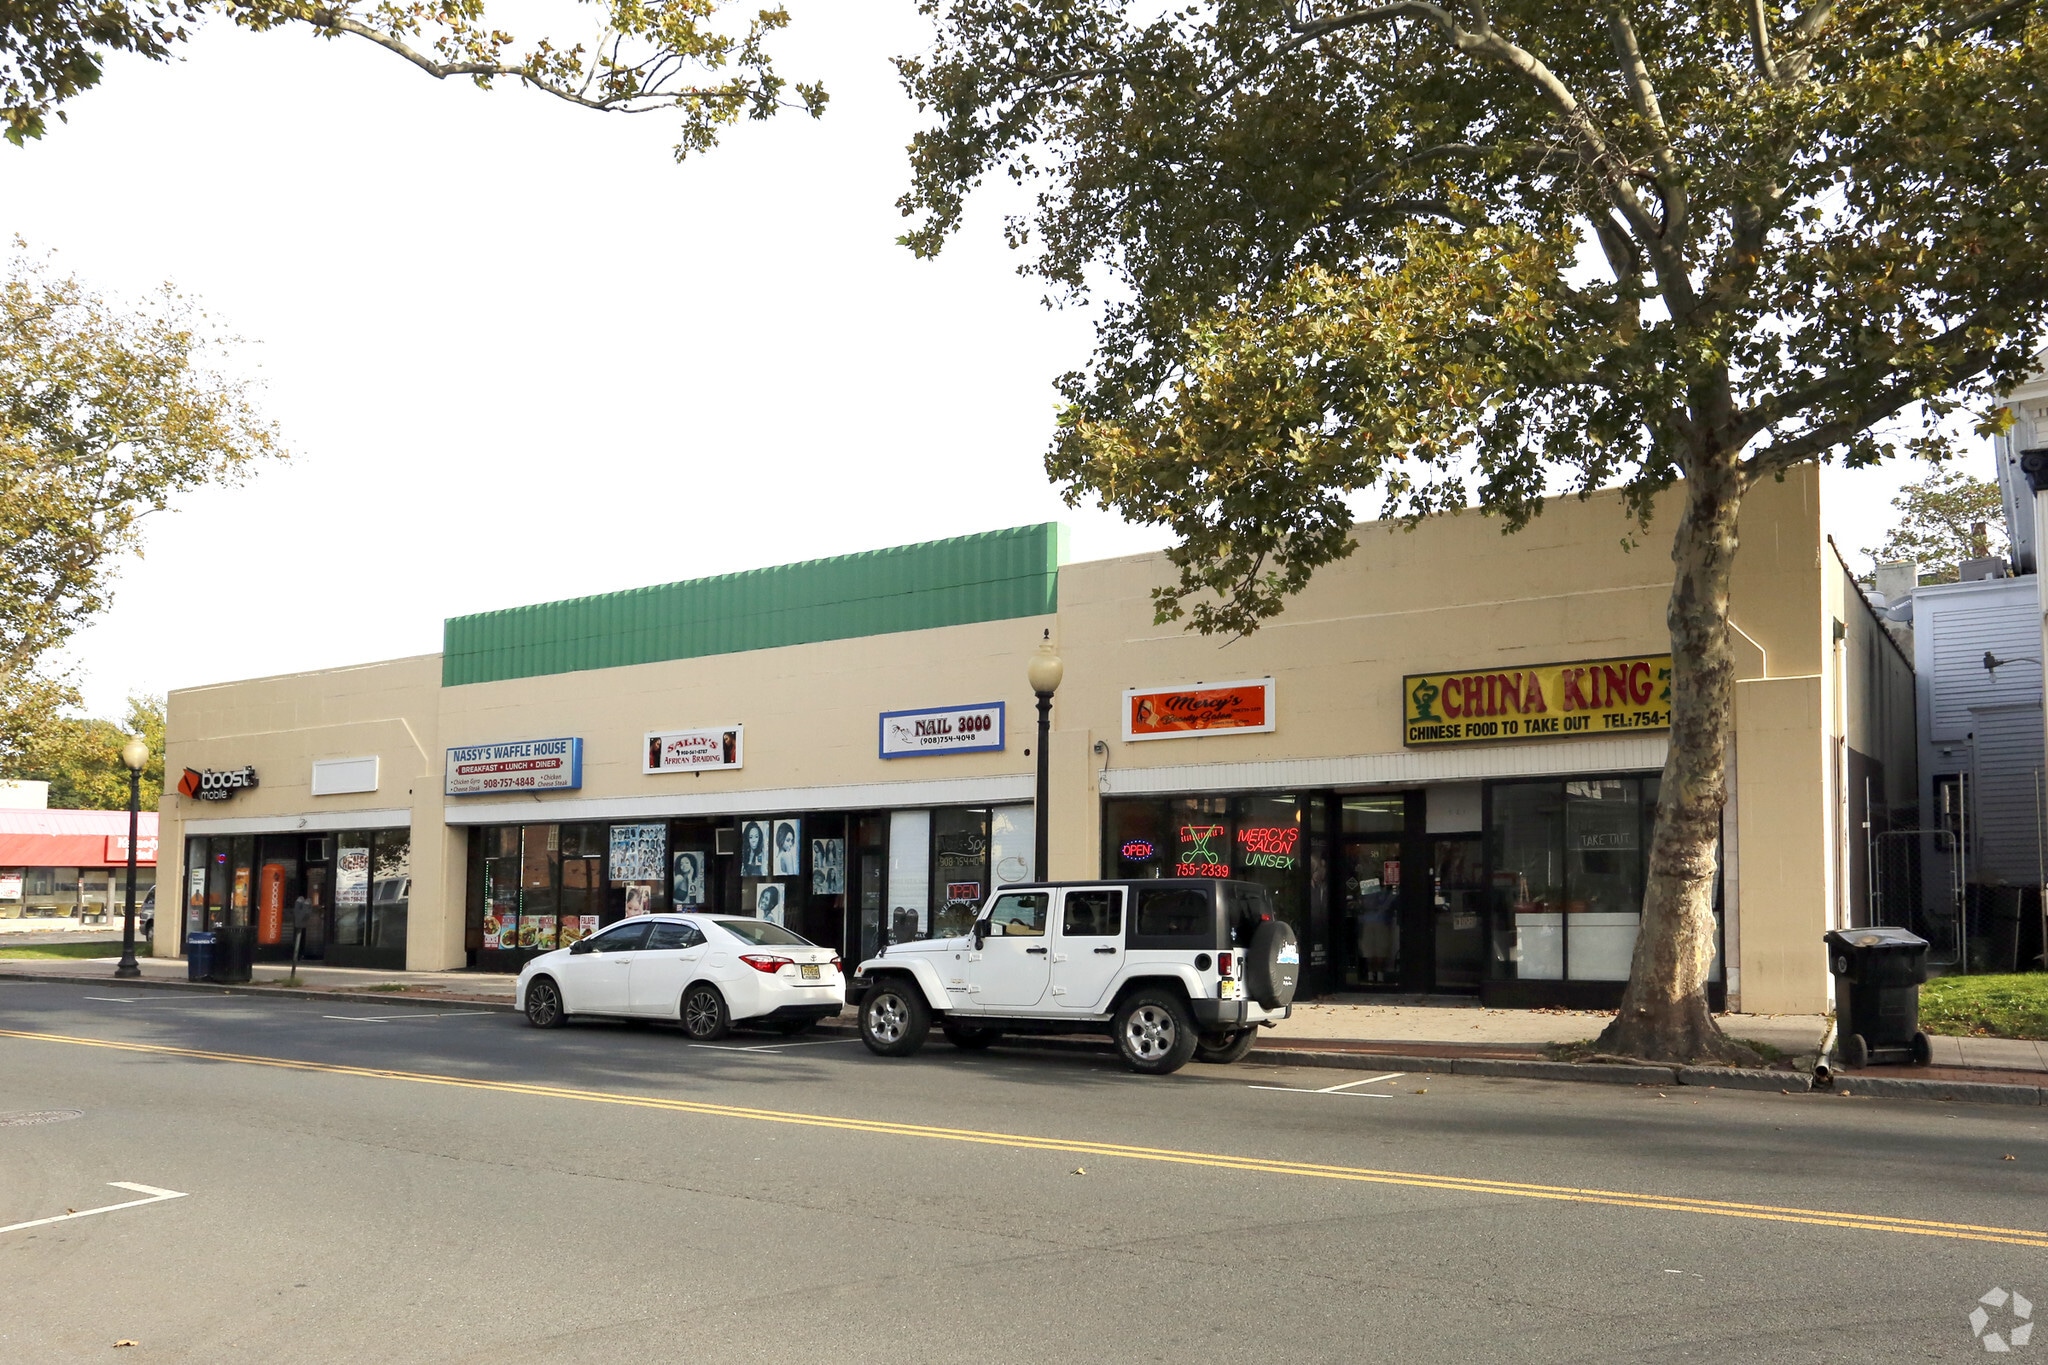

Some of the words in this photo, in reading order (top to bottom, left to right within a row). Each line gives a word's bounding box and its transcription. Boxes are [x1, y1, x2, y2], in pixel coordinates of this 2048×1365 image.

[1442, 671, 1548, 719] CHINA
[1562, 662, 1654, 712] KING
[1165, 695, 1243, 711] Mercy's
[1200, 711, 1233, 722] Salon
[914, 717, 952, 737] NAIL
[958, 714, 992, 733] 3000
[1409, 724, 1461, 741] CHINESE
[1465, 722, 1498, 737] FOOD
[1501, 720, 1518, 734] TO
[1525, 717, 1559, 734] TAKE
[1563, 715, 1591, 731] OUT
[667, 737, 719, 753] SALLY'S
[920, 734, 976, 746] (908)754-4048
[453, 748, 491, 762] NASSY'S
[494, 745, 531, 759] WAFFLE
[534, 742, 567, 756] HOUSE
[461, 764, 498, 774] BREAKFAST
[505, 762, 528, 771] LUNCH
[535, 760, 557, 768] DINER
[664, 756, 690, 765] AFRICAN
[692, 755, 721, 763] BRAIDING
[202, 767, 250, 789] boost
[202, 790, 227, 799] mobile
[1238, 827, 1299, 843] MERCY'S
[1580, 833, 1607, 847] TAKE
[1123, 844, 1152, 857] OPEN
[1246, 840, 1293, 854] SALON
[1245, 853, 1295, 870] UNISEX
[1176, 864, 1229, 877] 755-2339
[948, 884, 979, 899] OPEN
[939, 898, 970, 916] WELCOME
[970, 903, 978, 916] TO
